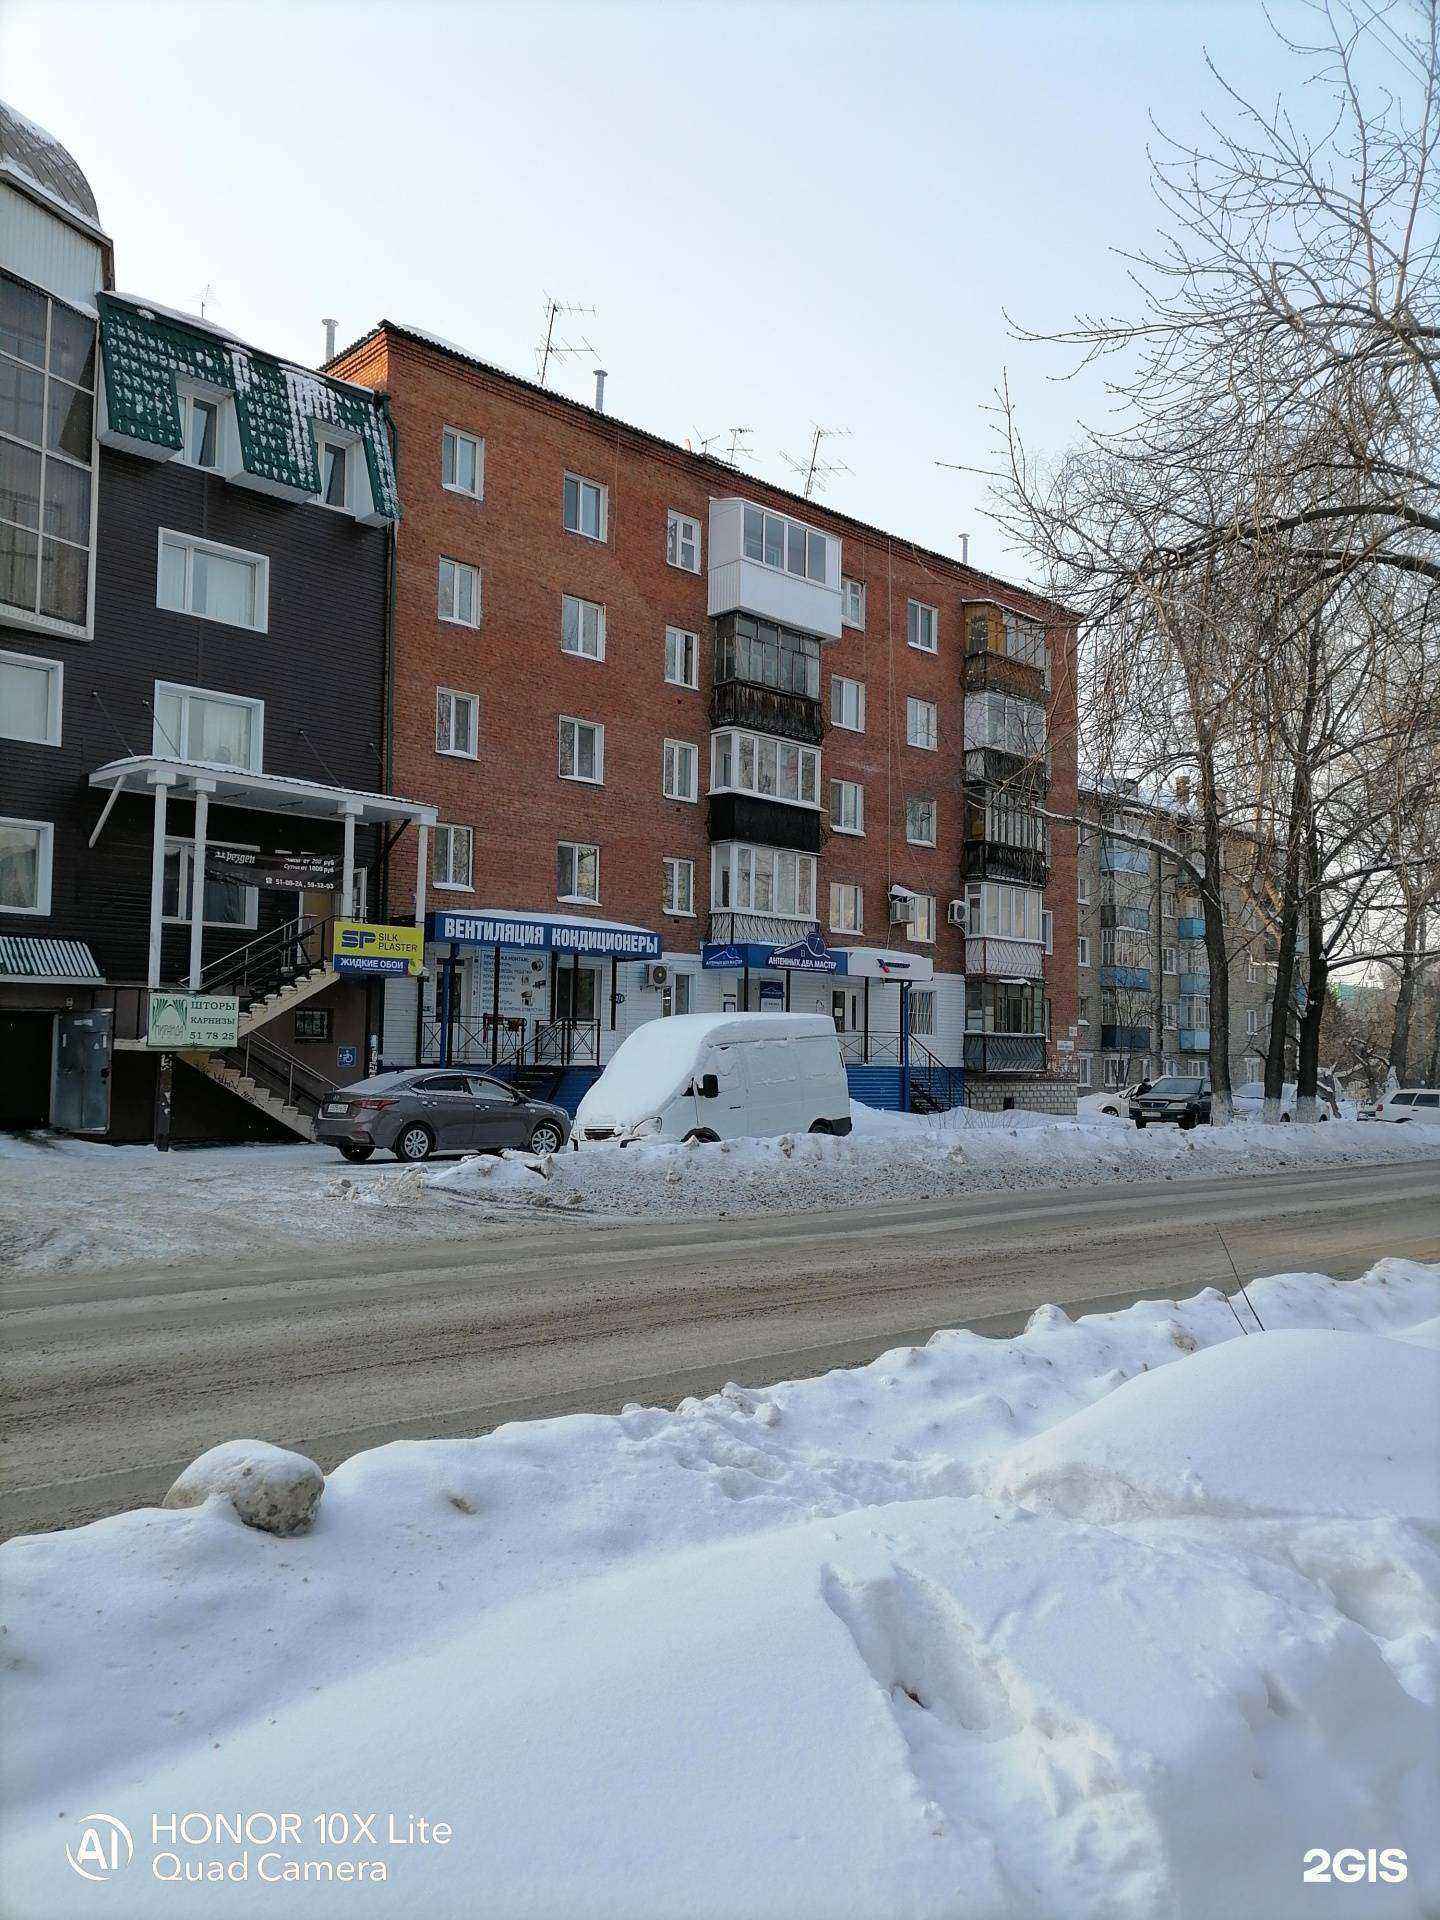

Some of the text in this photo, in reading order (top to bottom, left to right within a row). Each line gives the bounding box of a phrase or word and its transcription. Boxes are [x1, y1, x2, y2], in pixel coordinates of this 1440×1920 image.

[341, 930, 376, 948] SP
[379, 932, 398, 942] SILK
[444, 917, 658, 954] ВЕНТИЛЯЦИЯ КОНДИЦИОНЕРЫ
[379, 942, 418, 952] PLASTER
[340, 957, 404, 969] ЖИДКИЕ ОБОИ
[814, 960, 837, 970] МАСТЕР
[191, 1001, 236, 1011] ШТОРЫ
[190, 1016, 235, 1025] КАРНИЗЫ
[190, 1031, 202, 1040] 51
[206, 1032, 219, 1040] 78
[221, 1032, 235, 1040] 25
